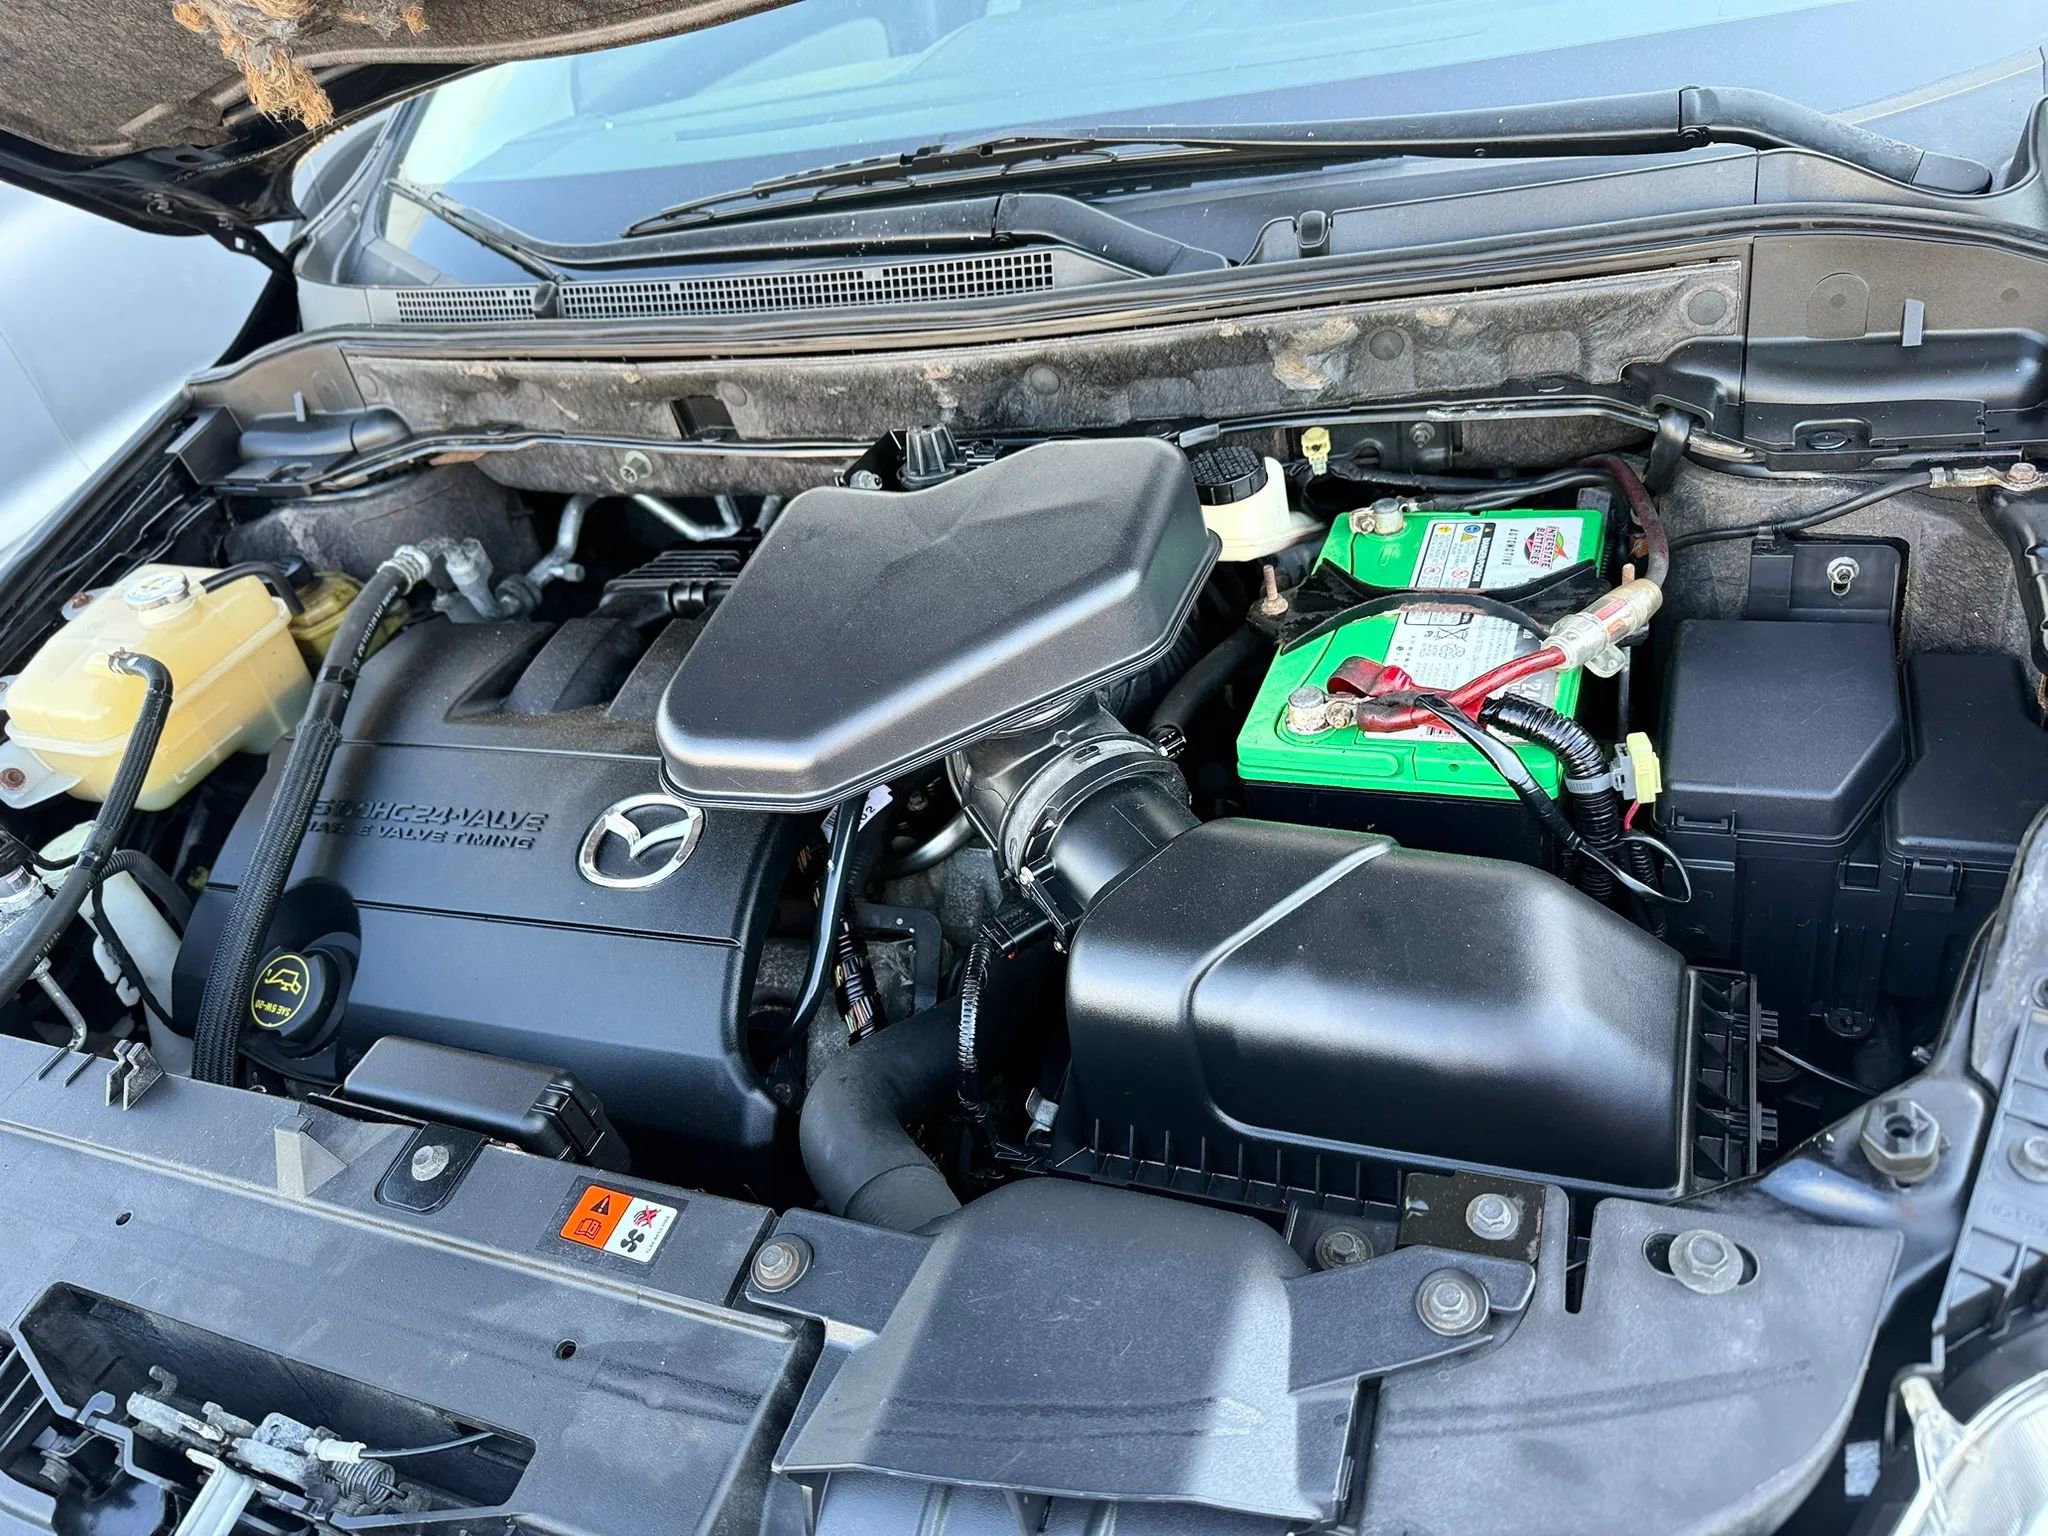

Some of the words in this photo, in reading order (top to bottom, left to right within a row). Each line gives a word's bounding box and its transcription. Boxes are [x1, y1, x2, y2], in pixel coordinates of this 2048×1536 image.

[1501, 528, 1519, 566] AUTOMOTIVE
[1530, 527, 1546, 565] BATTERIES
[1541, 526, 1559, 568] INTERSTATE
[378, 825, 449, 843] VALVE
[452, 831, 536, 850] TIMING
[254, 999, 278, 1013] 5W-20
[276, 1004, 292, 1017] SAE
